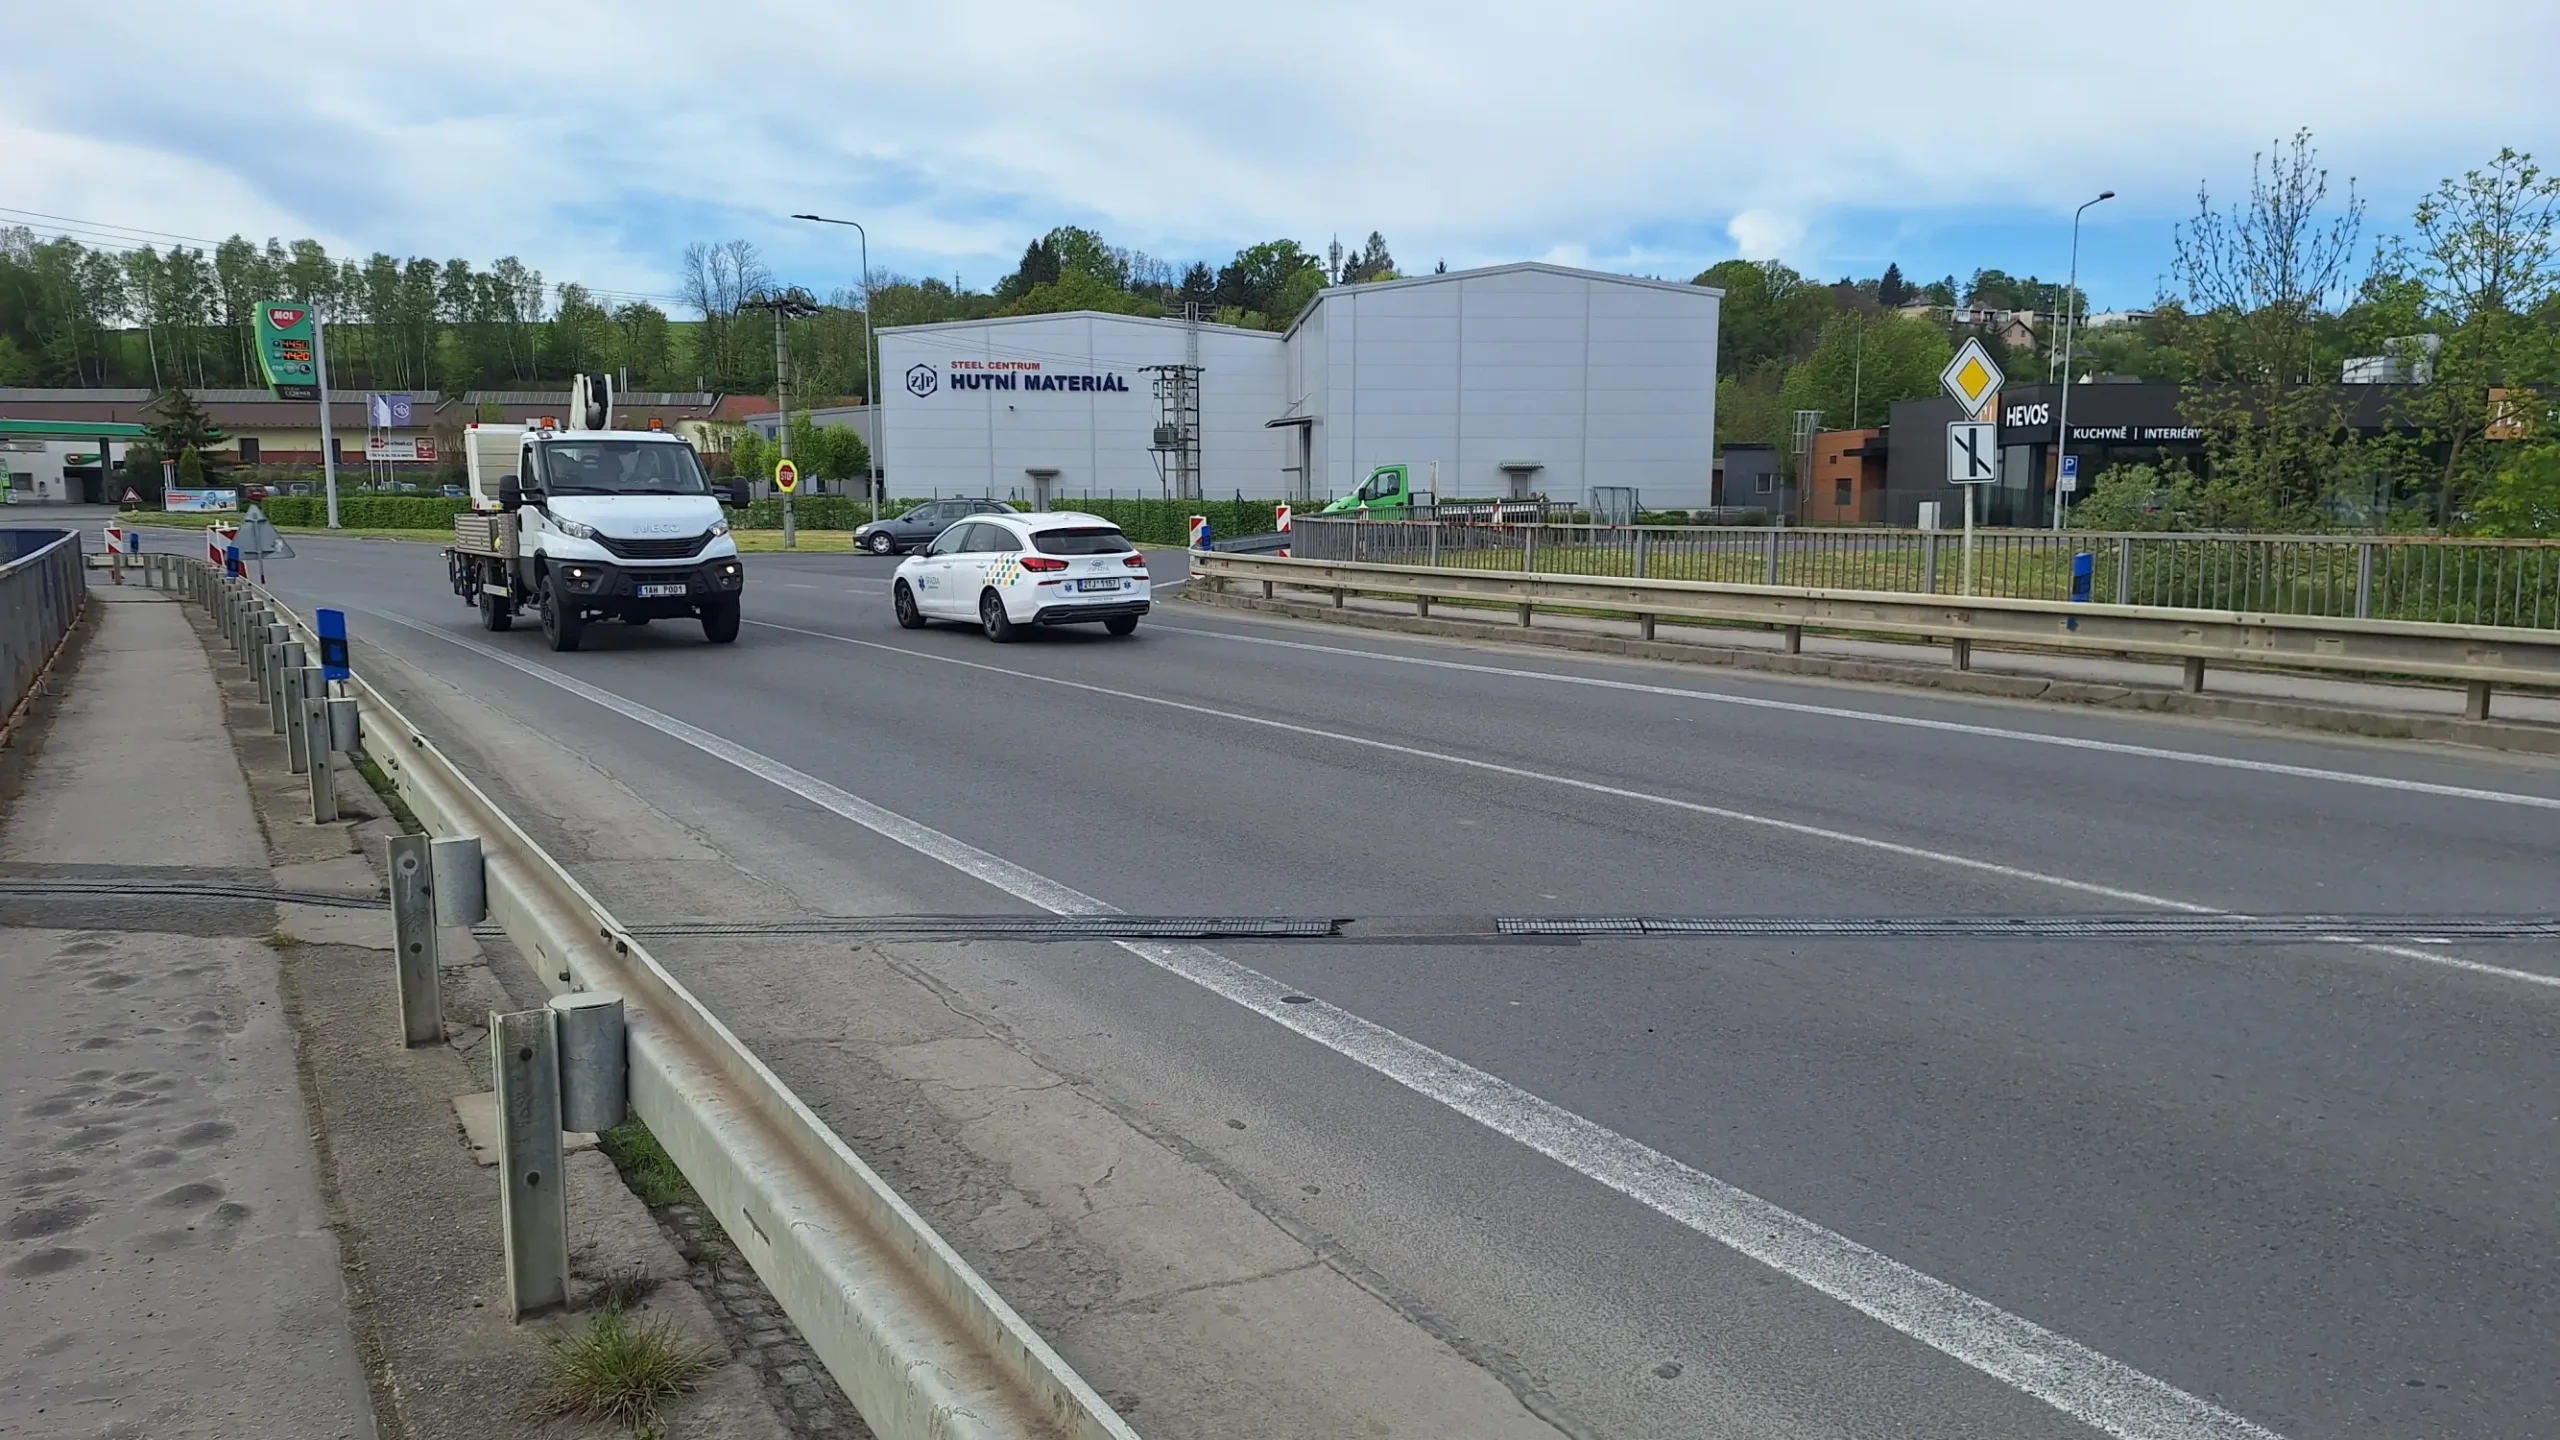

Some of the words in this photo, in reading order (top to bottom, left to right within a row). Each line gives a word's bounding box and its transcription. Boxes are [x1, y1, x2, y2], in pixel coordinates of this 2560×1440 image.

[273, 311, 293, 320] MOL
[951, 361, 984, 369] STEEL
[988, 361, 1041, 371] CENTRUM
[911, 373, 935, 391] ZJP
[951, 371, 1016, 390] HUTNÍ
[1024, 372, 1130, 392] MATERIÁL
[2006, 403, 2050, 427] HEVOS
[2073, 426, 2127, 440] KUCHYNĚ
[2144, 427, 2202, 440] INTERIÉRY
[781, 471, 794, 481] STOP
[633, 524, 681, 534] IVECO
[644, 586, 659, 594] 1AH
[1084, 581, 1096, 589] 2TJ
